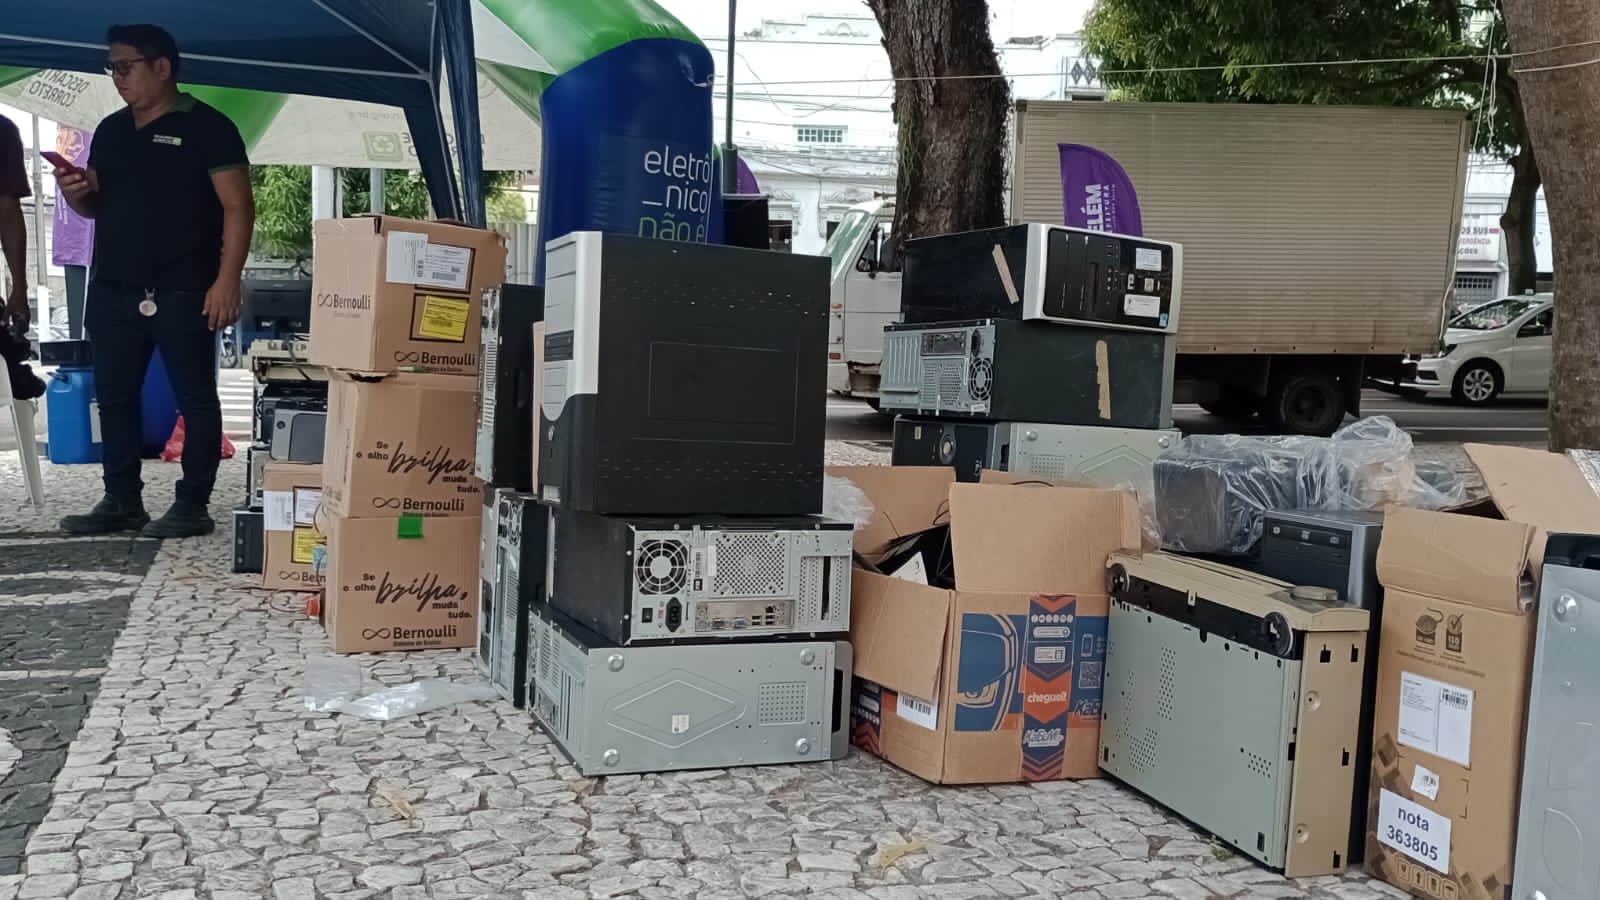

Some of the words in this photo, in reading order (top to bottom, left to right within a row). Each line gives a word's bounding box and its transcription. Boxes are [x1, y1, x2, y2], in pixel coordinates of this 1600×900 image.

[644, 145, 711, 183] eletrô
[639, 212, 690, 242] não
[333, 294, 371, 309] Bernoulli
[421, 351, 476, 366] Bernoulli
[376, 441, 389, 449] Se
[403, 497, 465, 511] Bernoulli
[363, 573, 376, 581] Se
[354, 583, 376, 591] olho
[392, 624, 457, 639] Bernoulli
[1398, 807, 1429, 832] nota
[1387, 824, 1438, 861] 363805
